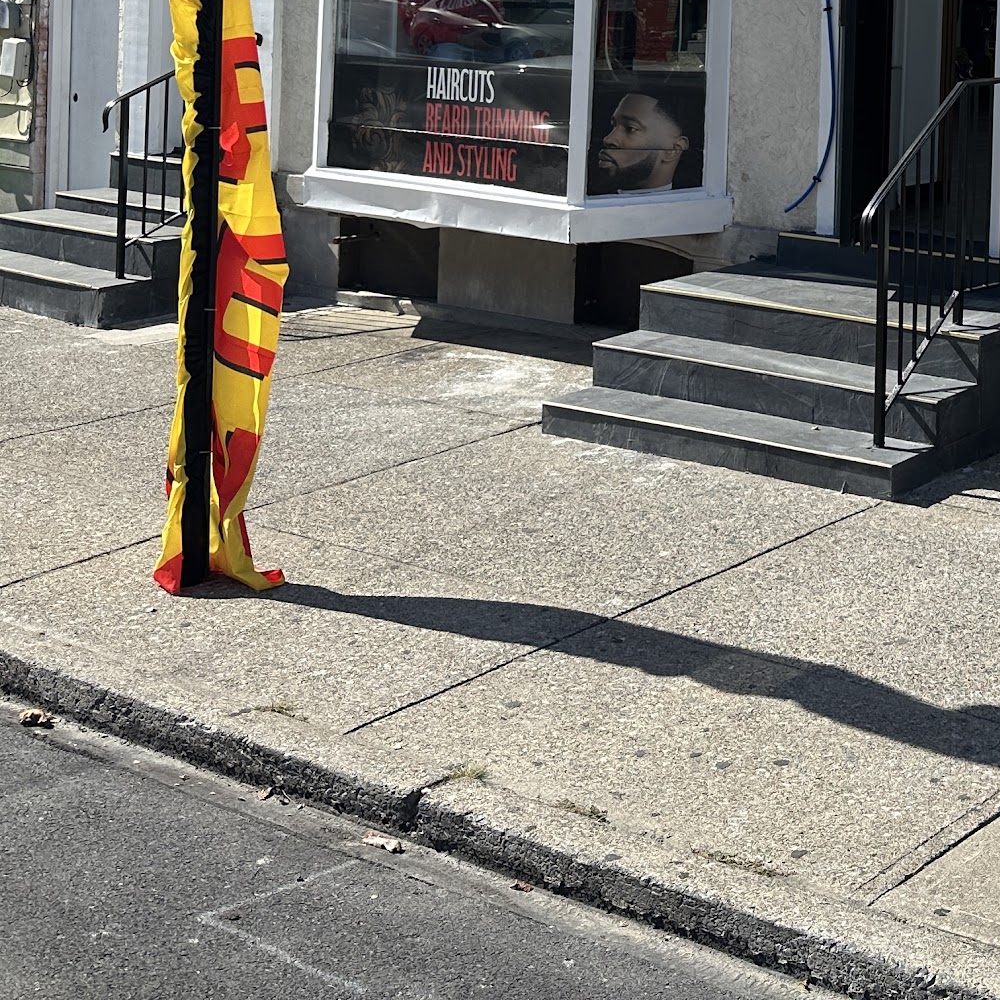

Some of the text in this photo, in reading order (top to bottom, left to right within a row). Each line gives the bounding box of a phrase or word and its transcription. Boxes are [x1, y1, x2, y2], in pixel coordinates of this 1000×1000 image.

[426, 66, 495, 104] HAIRCUTS
[425, 102, 550, 143] BEARD TRIMMING
[422, 141, 518, 182] AND STYLING
